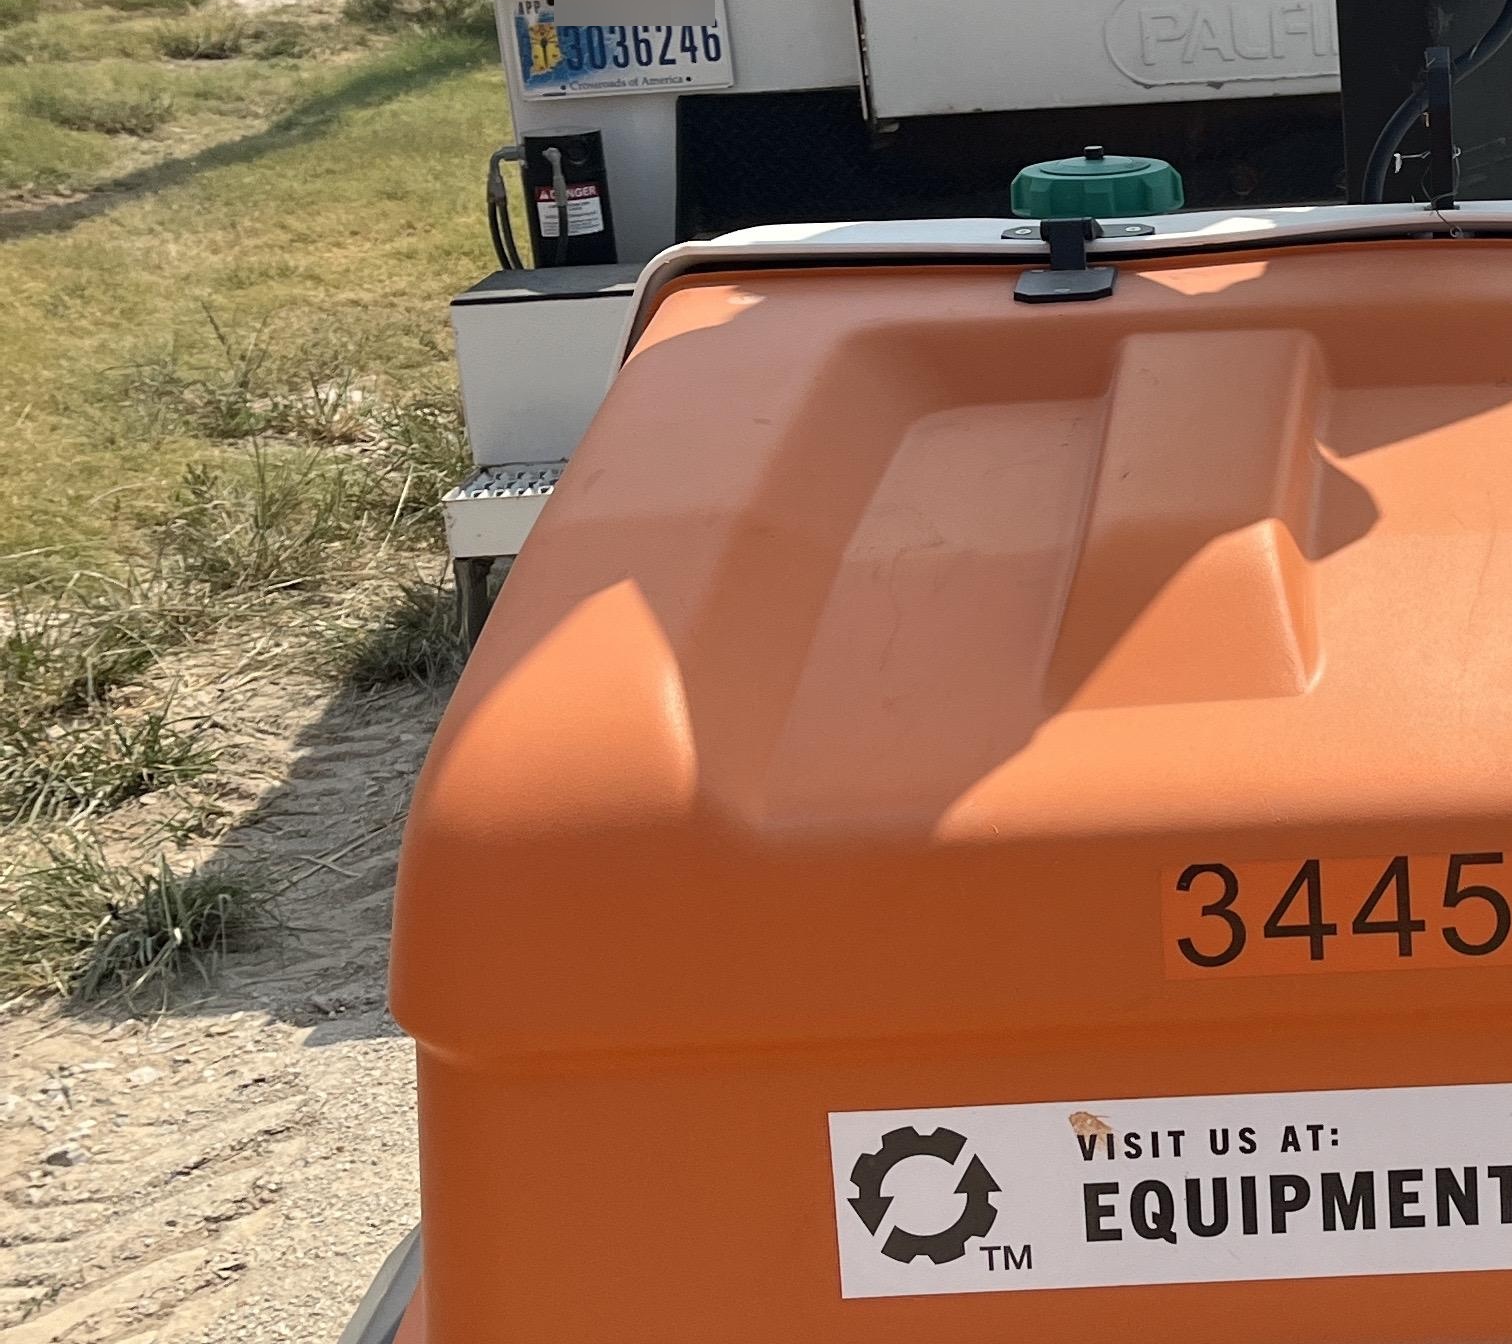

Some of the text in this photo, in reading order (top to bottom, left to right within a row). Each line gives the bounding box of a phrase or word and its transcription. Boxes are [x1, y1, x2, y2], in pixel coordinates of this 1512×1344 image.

[550, 184, 598, 200] DNGER
[1076, 1124, 1338, 1160] VISIT US AT:
[979, 1244, 1032, 1270] TM
